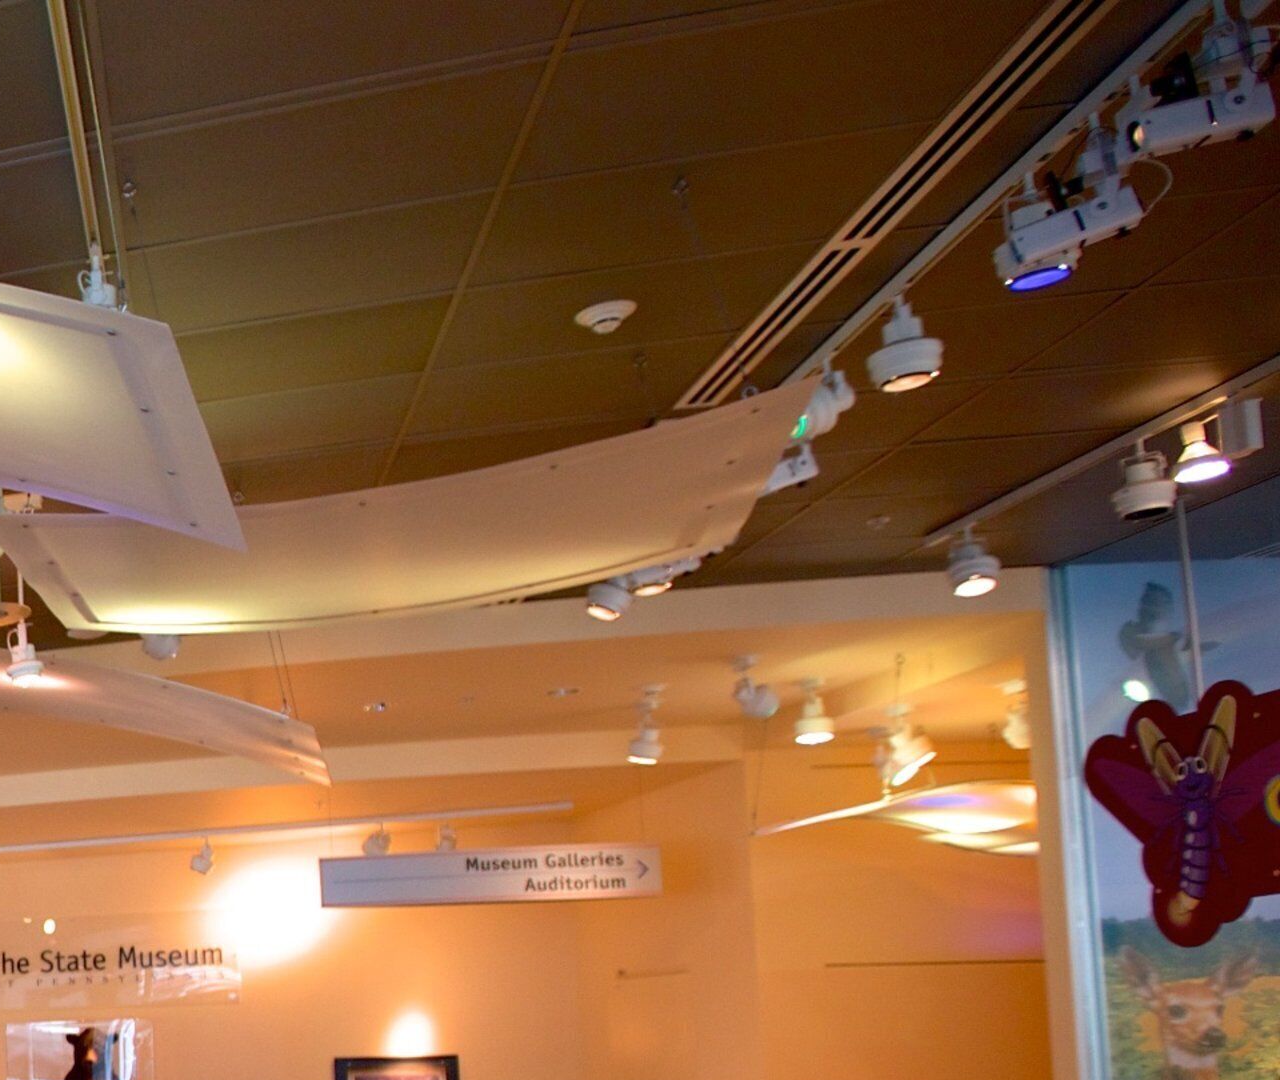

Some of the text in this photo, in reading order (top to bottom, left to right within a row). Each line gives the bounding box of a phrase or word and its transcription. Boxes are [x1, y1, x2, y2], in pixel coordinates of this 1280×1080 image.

[466, 852, 624, 872] Museum Galleries
[525, 874, 627, 893] Auditorium
[40, 948, 107, 974] State
[118, 945, 223, 970] Museum
